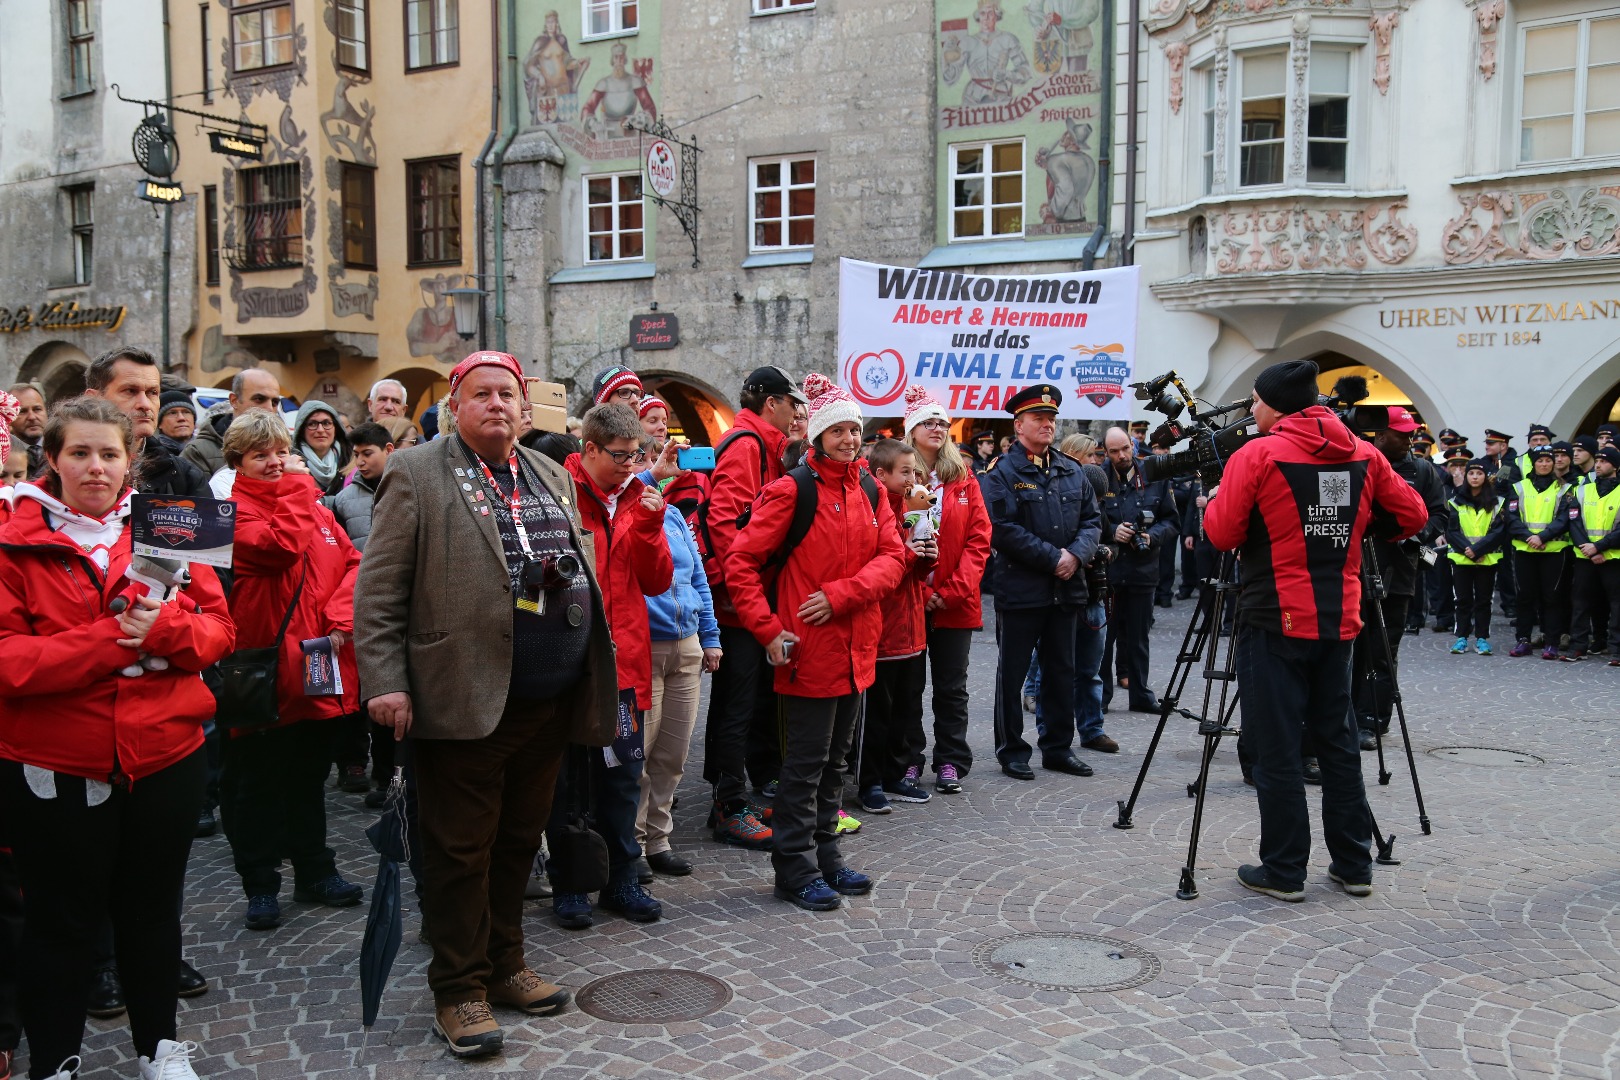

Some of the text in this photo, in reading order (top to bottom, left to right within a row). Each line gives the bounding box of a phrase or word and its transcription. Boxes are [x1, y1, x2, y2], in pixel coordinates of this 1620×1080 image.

[651, 160, 673, 181] HANDL
[146, 182, 182, 201] Happ
[878, 268, 1102, 305] Willkommen
[243, 287, 369, 315] Weinhaus Happ
[641, 318, 667, 332] Speck
[892, 304, 1088, 328] Albert & Hermann
[1379, 306, 1467, 328] UHREN
[636, 332, 671, 344] Tirolese
[951, 329, 1030, 350] und das
[1457, 331, 1542, 348] SEIT 1894
[914, 352, 1065, 381] FINAL LEG
[1075, 366, 1127, 377] FINAL LEG
[152, 514, 178, 522] FINAL
[180, 515, 198, 525] LEG
[1307, 505, 1338, 516] tirol
[1304, 523, 1350, 537] PRESSE
[1331, 536, 1349, 548] TV
